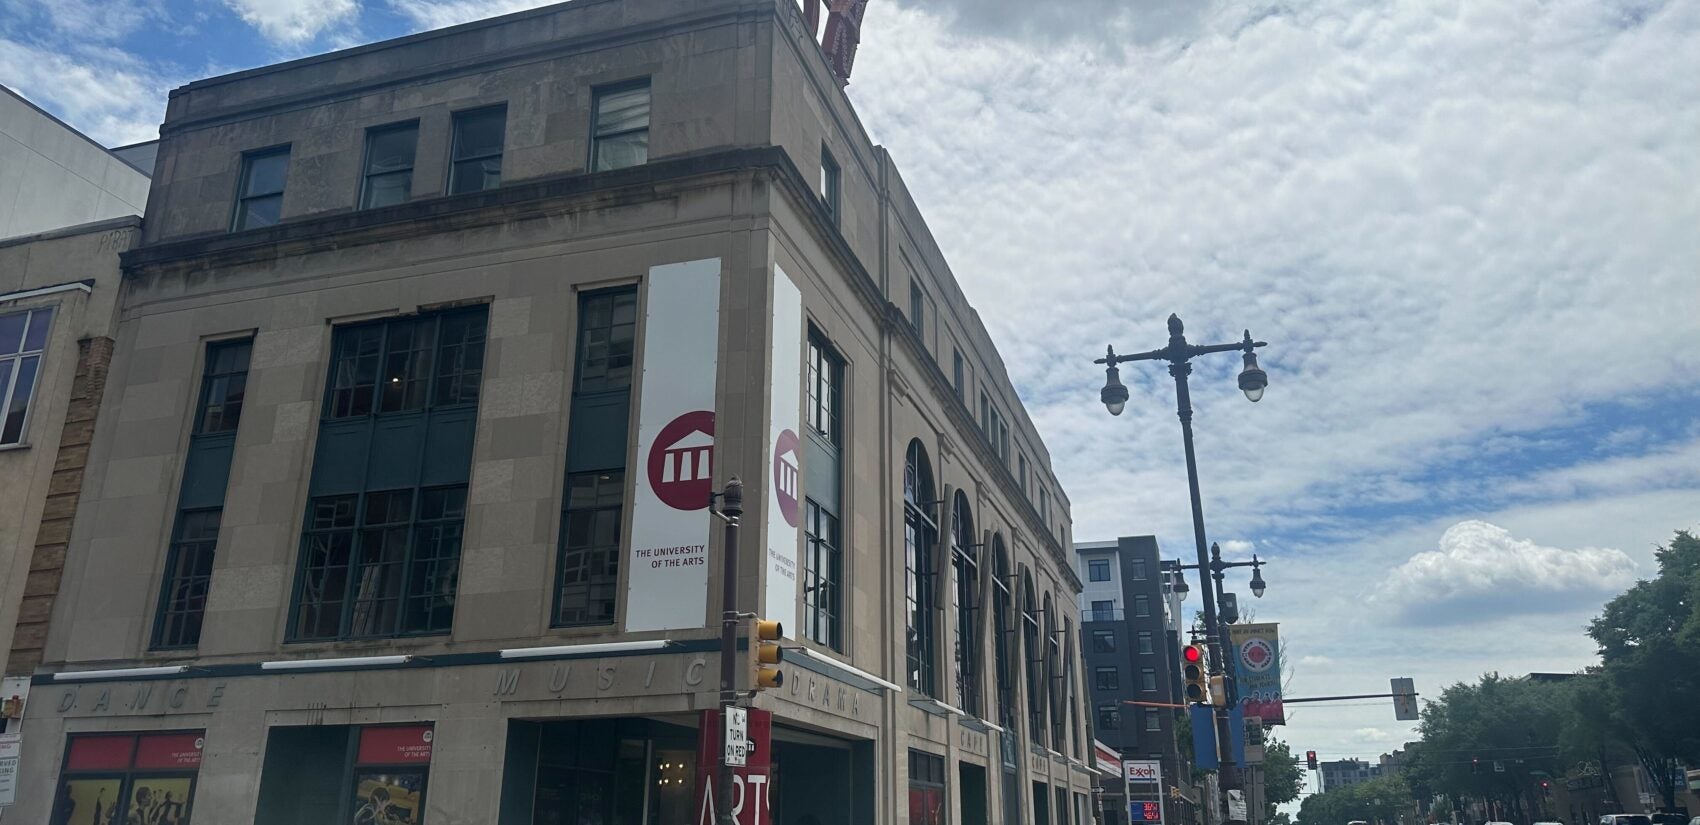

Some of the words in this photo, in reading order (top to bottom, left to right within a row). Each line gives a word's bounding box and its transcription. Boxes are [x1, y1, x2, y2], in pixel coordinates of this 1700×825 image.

[636, 549, 651, 558] THE
[654, 545, 705, 557] UNIVERSITY
[651, 559, 662, 568] OF
[665, 559, 680, 568] THE
[682, 557, 704, 567] ARTS
[493, 658, 706, 696] MUSIC
[57, 681, 228, 713] DANCE
[791, 671, 860, 715] DRAMA
[730, 728, 744, 742] TURN
[727, 744, 735, 756] ON
[736, 745, 746, 758] RED
[1129, 766, 1156, 778] Exxon
[700, 774, 770, 825] ART
